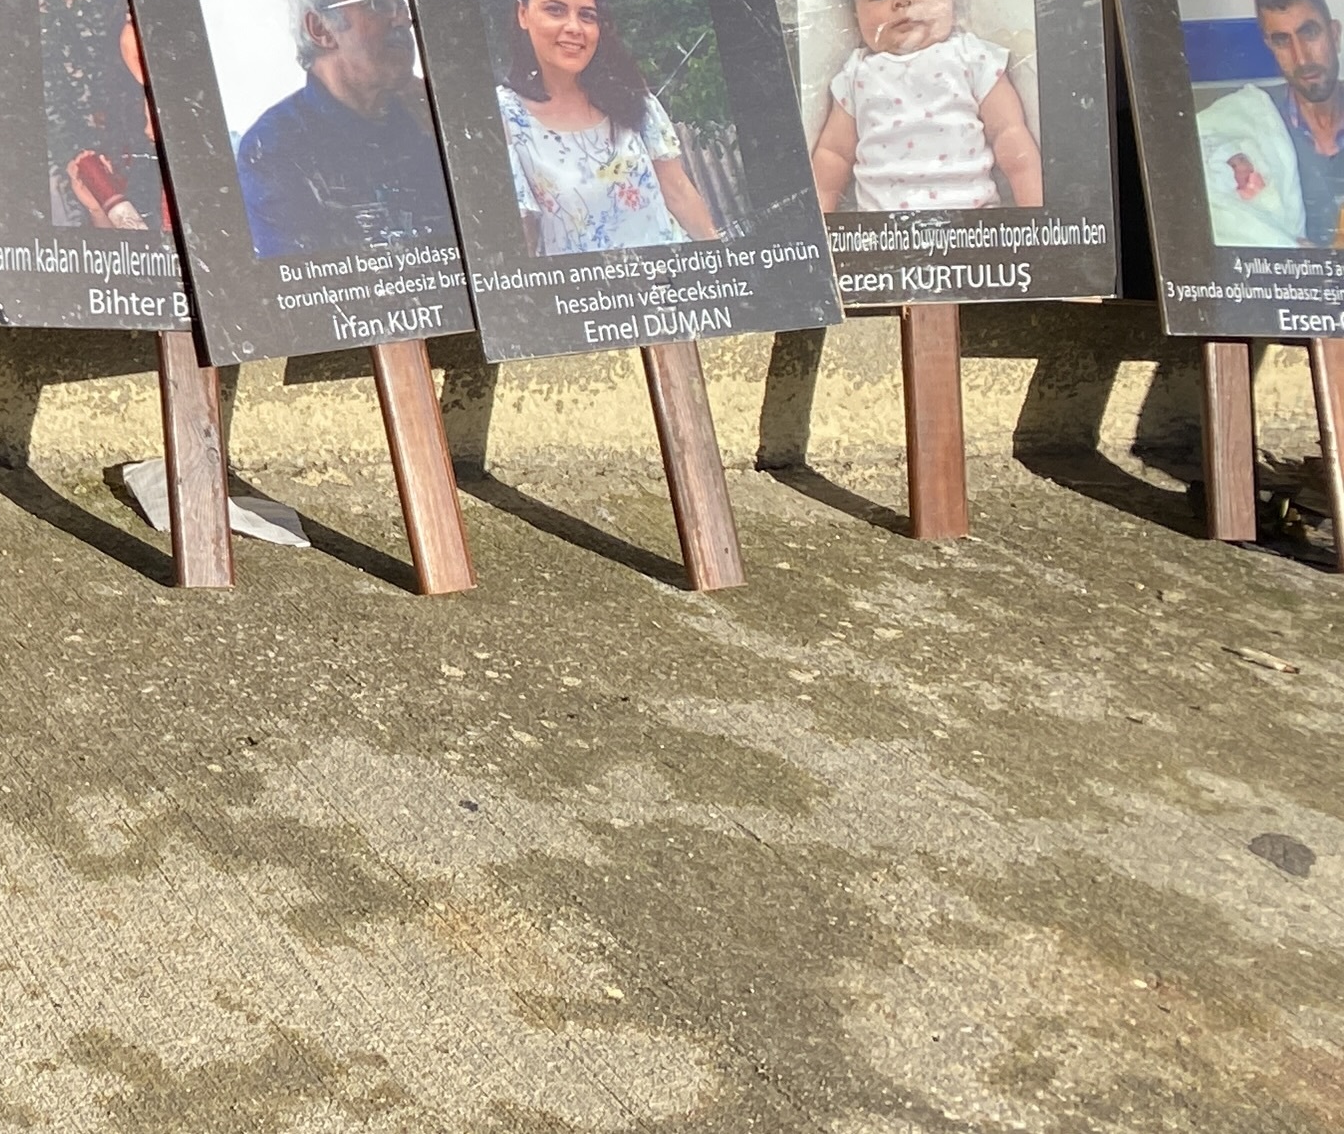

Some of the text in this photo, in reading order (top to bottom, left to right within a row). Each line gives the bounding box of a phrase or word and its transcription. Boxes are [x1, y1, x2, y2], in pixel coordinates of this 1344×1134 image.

[880, 222, 910, 251] daha
[1001, 219, 1040, 253] toprak
[1041, 218, 1082, 246] oldum
[1083, 217, 1106, 246] ben
[35, 237, 80, 274] kalan
[279, 245, 461, 282] Bu ihmal beni yoldaşsı
[472, 242, 820, 293] Evladımın annesiz geçirdiği her günün
[1233, 257, 1243, 273] 4
[1325, 260, 1333, 277] 5
[277, 269, 467, 310] torunlarımı dedesiz bıra
[555, 277, 754, 314] hesabını vereceksiniz.
[839, 262, 1032, 293] eren KURTULUŞ
[1167, 281, 1175, 298] 3
[1177, 282, 1224, 301] yaşında
[1225, 282, 1272, 303] oğlumu
[89, 288, 165, 316] Bihter
[332, 305, 444, 340] İrfan KURT
[583, 306, 732, 343] Emel DUMAN
